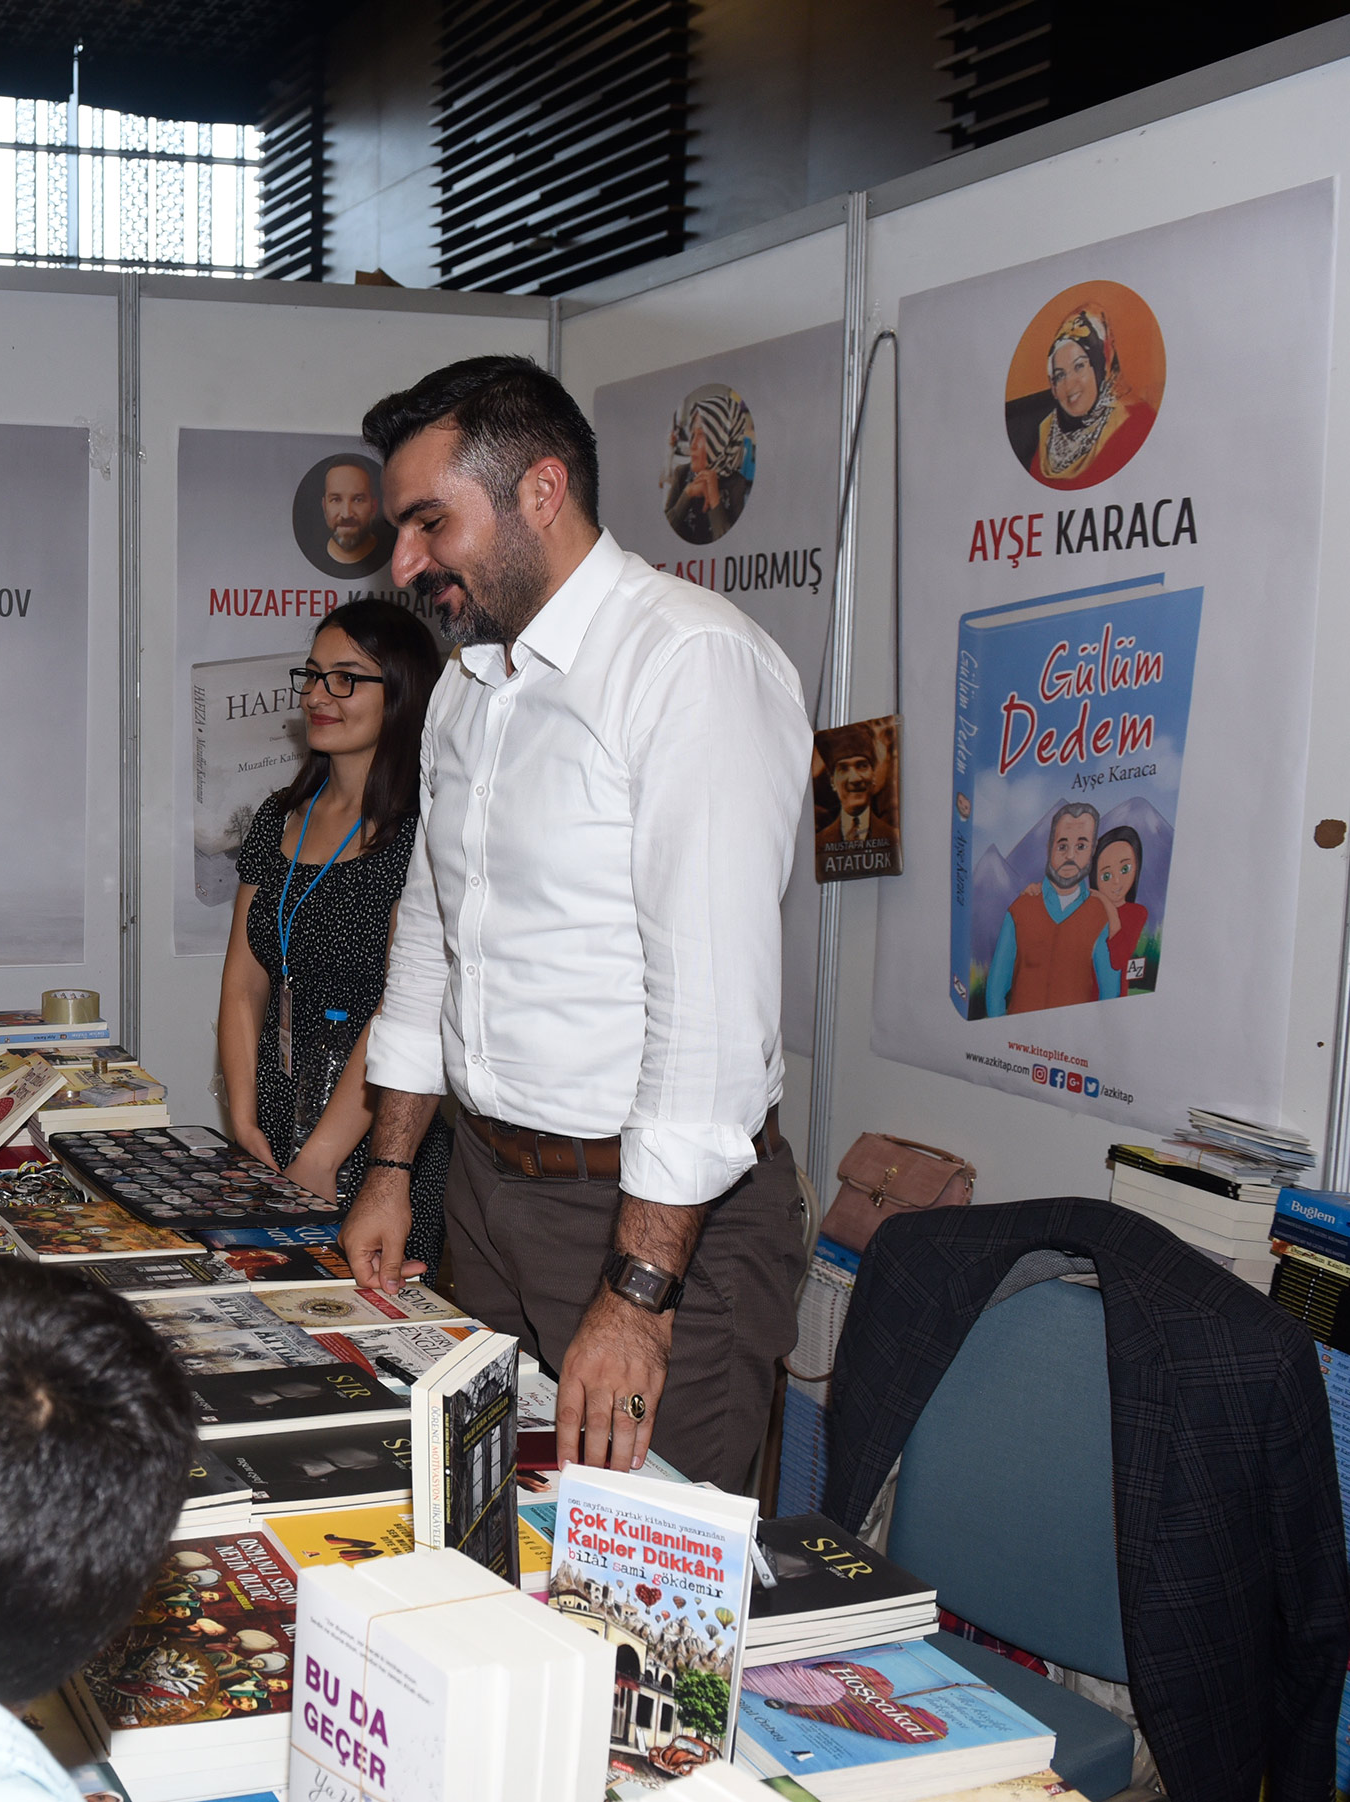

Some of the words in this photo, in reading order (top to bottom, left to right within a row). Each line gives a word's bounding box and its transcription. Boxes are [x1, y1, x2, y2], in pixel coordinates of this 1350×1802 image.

[968, 513, 1044, 569] AYŞE
[1056, 497, 1198, 555] KARACA
[724, 547, 823, 594] DURMUŞ
[209, 588, 338, 617] MUZAFFER
[959, 649, 980, 711] Gülüm
[1039, 622, 1163, 703] Gülüm
[193, 684, 206, 726] HAFIZA
[955, 713, 979, 776] Dedem
[998, 691, 1155, 777] Dedem
[237, 755, 278, 774] Muzaffer
[1071, 772, 1105, 793] Ayşe
[1108, 762, 1158, 784] Karaca
[825, 840, 864, 852] MUSTAFA
[825, 848, 891, 873] ATATÜRK
[965, 1051, 1030, 1076] www.azkitap.com
[1100, 1084, 1134, 1105] /azkitap
[1008, 1040, 1089, 1068] www.kitaplife.com
[1291, 1200, 1337, 1225] Buğlem
[326, 1374, 372, 1400] SIR
[430, 1405, 442, 1444] ÖĞRENCİ
[430, 1445, 442, 1501] MOTİVASYON
[569, 1507, 607, 1532] Çok
[614, 1517, 724, 1565] Kullanılmış
[615, 1508, 642, 1522] yırtık
[645, 1514, 677, 1530] kitabın
[678, 1524, 726, 1542] yazarından
[215, 1545, 252, 1571] NEYİN
[236, 1573, 278, 1601] OLUR?
[237, 1538, 282, 1576] OSMANLI
[567, 1527, 637, 1559] Kalpler
[643, 1546, 725, 1583] Dükkânı
[568, 1547, 608, 1569] bilâl
[612, 1561, 647, 1580] sami
[652, 1572, 724, 1599] gökdemir
[802, 1536, 873, 1581] SIR
[305, 1653, 340, 1708] BU
[349, 1688, 389, 1749] DA
[829, 1667, 937, 1739] Hoşçakal
[304, 1701, 387, 1790] GEÇER
